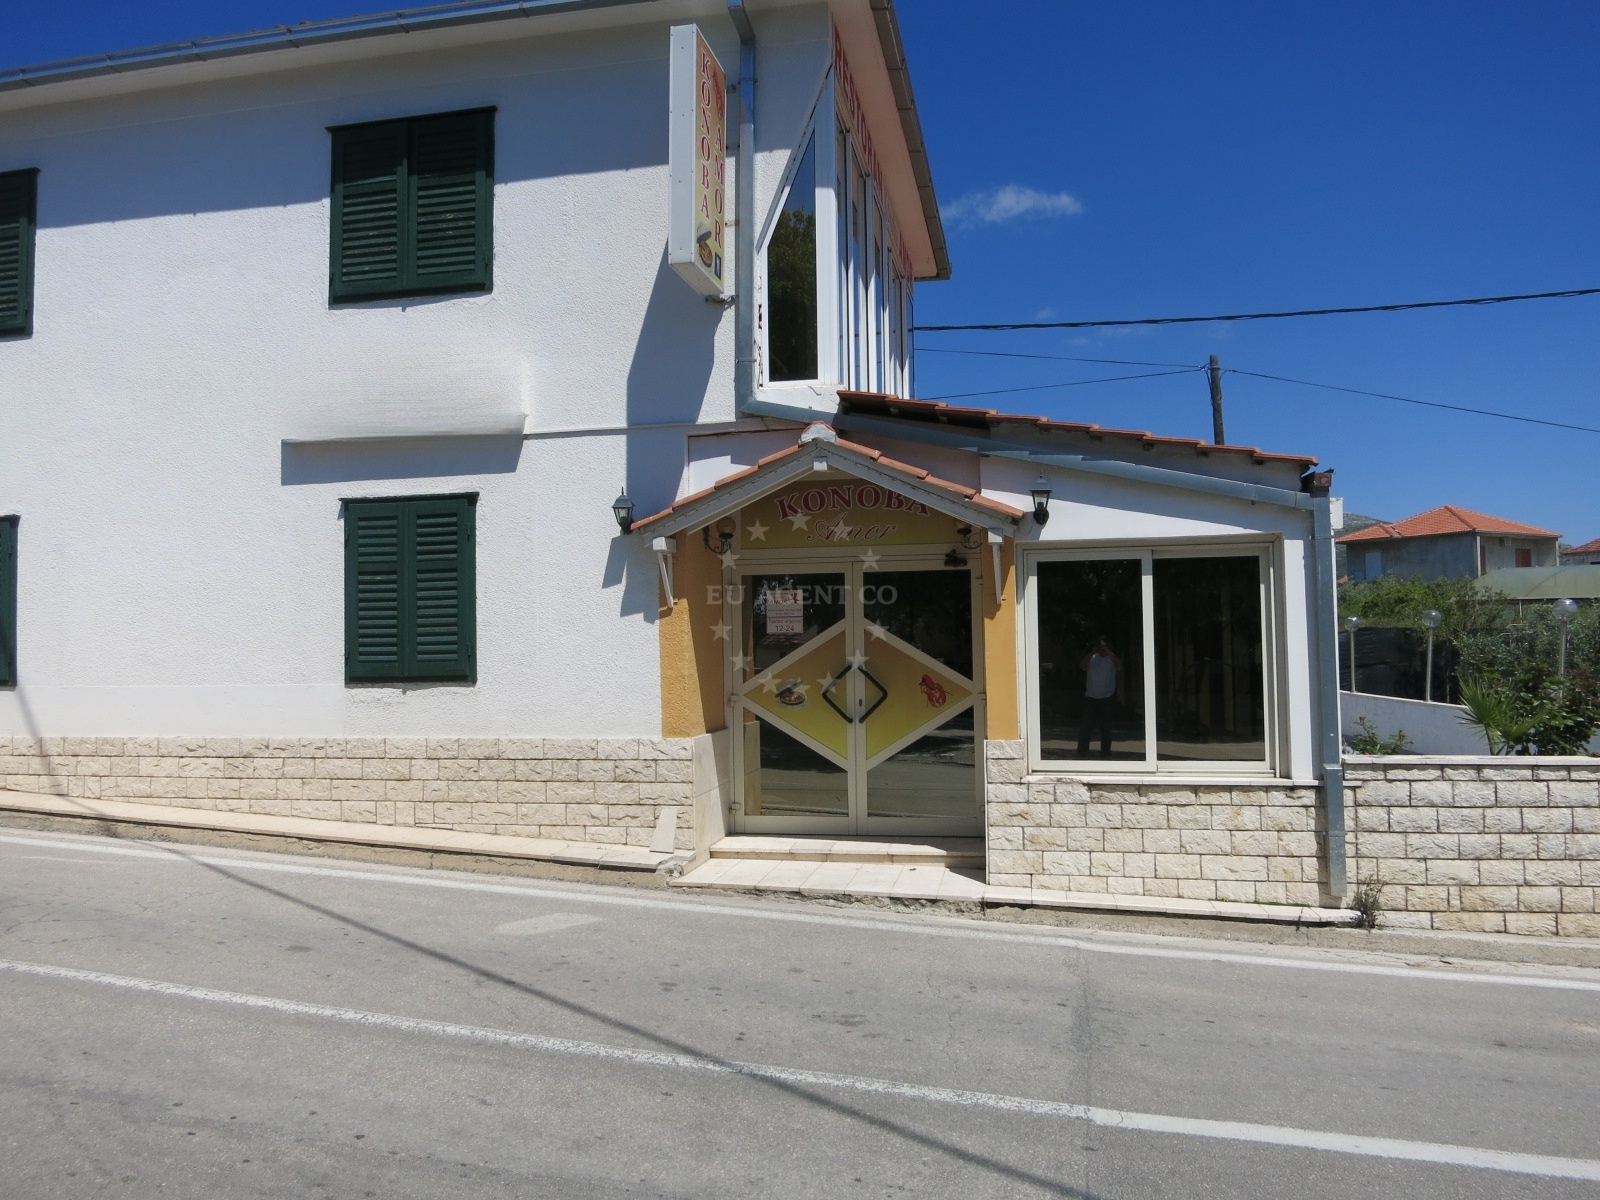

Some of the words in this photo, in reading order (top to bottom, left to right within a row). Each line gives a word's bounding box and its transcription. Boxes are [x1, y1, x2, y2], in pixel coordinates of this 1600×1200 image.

[701, 50, 711, 220] KONOBA
[714, 124, 724, 250] AMOR
[775, 485, 930, 520] KONOBA
[807, 512, 898, 543] Amor
